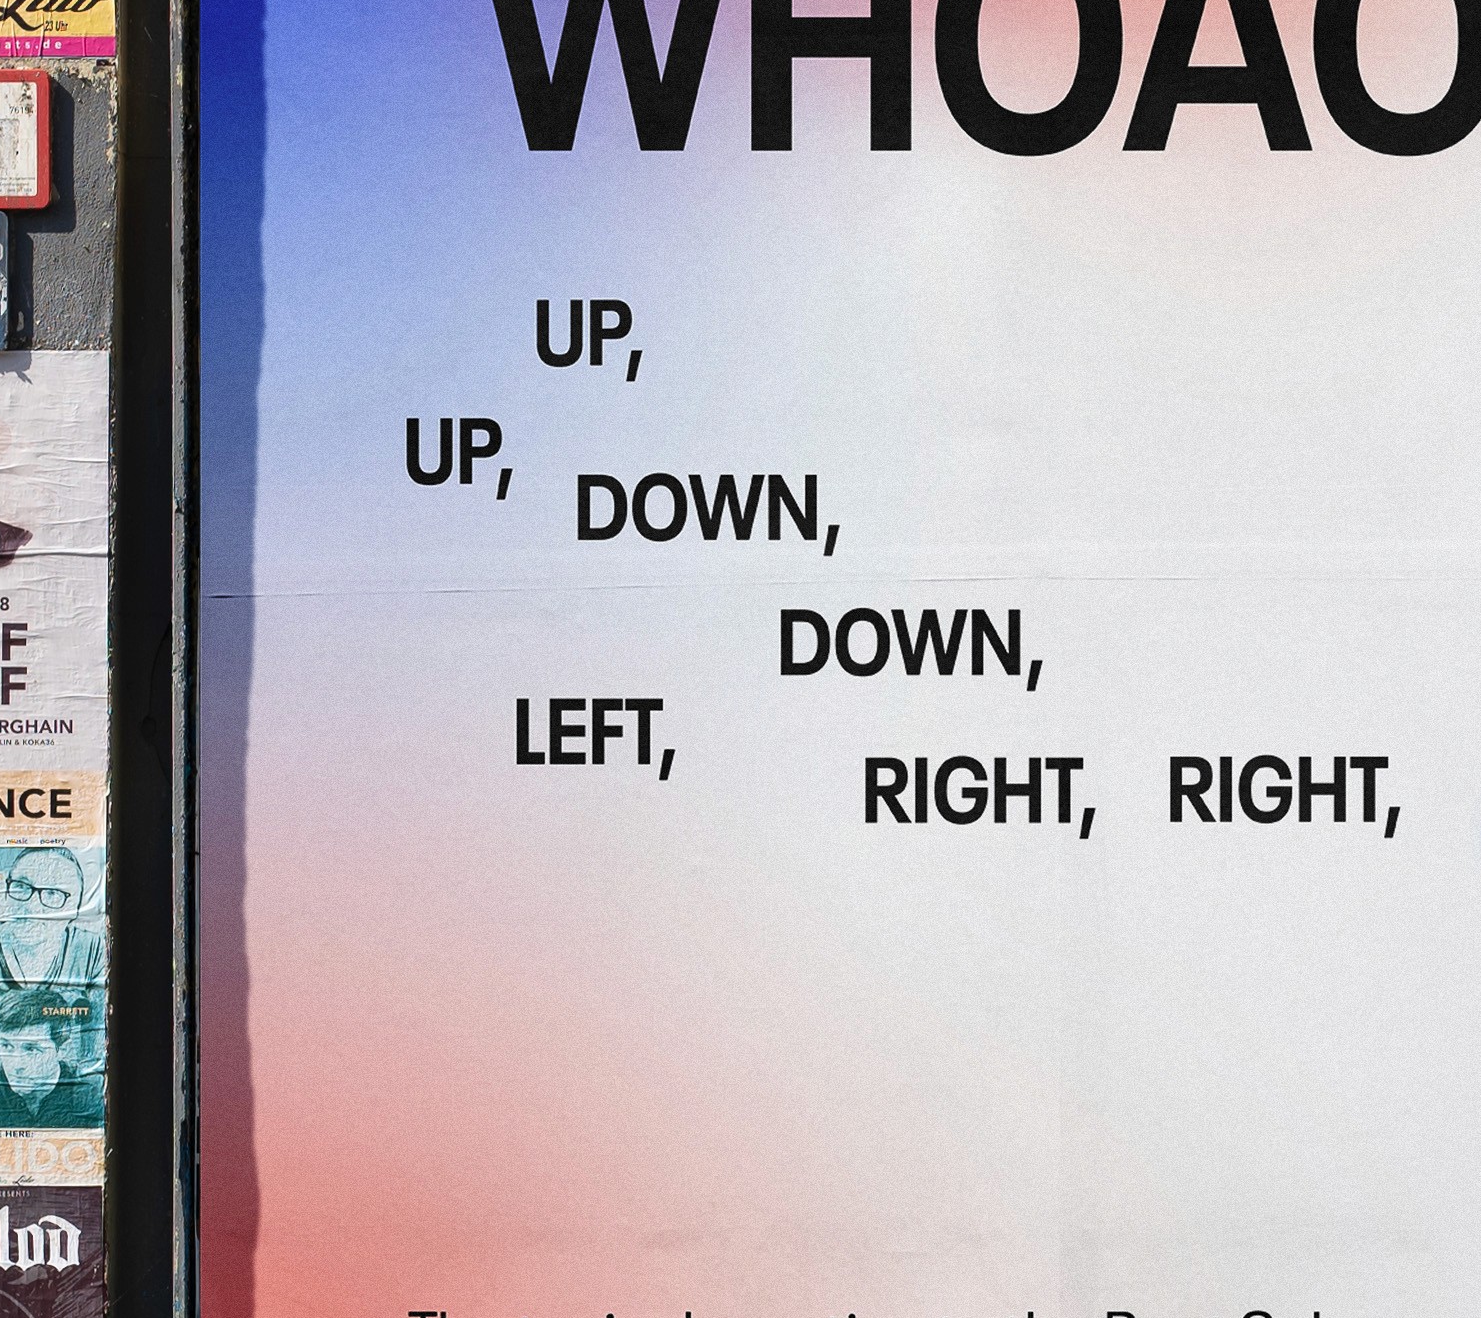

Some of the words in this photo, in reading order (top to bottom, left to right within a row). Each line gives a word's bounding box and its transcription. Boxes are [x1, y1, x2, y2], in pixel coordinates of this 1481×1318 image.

[534, 298, 643, 382] UP,
[404, 417, 514, 501] UP,
[576, 473, 840, 558] DOWN,
[778, 607, 1044, 692] DOWN,
[515, 697, 675, 781] LEFT,
[863, 755, 1097, 839] RIGHT,
[1168, 754, 1400, 838] RIGHT,
